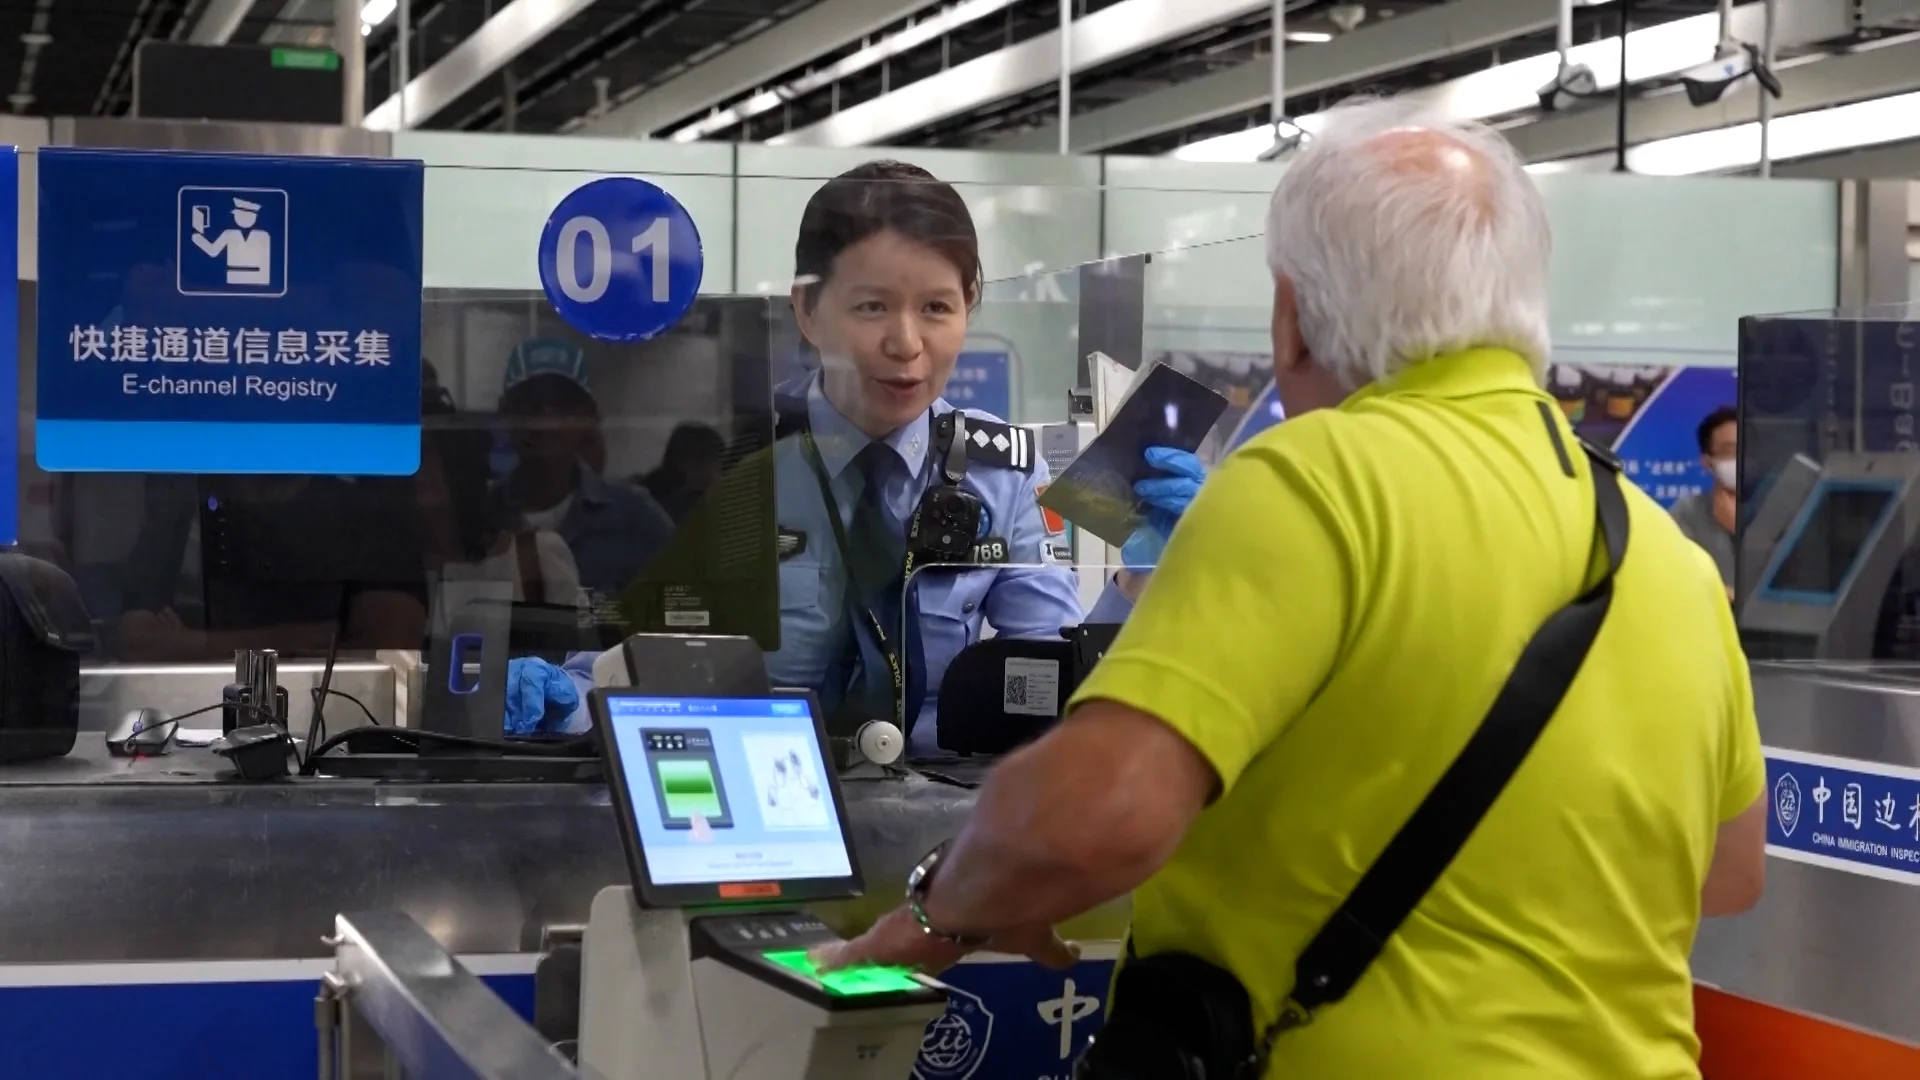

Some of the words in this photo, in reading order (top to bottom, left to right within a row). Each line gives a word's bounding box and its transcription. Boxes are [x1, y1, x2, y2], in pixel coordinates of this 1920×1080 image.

[556, 214, 670, 303] 01
[69, 325, 391, 367] 快捷通道信息采集
[123, 374, 237, 396] E-channel
[245, 376, 337, 401] Registry
[1812, 832, 1836, 847] CHINA
[1837, 837, 1888, 858] IMMIGRATION
[1037, 978, 1100, 1060] 中
